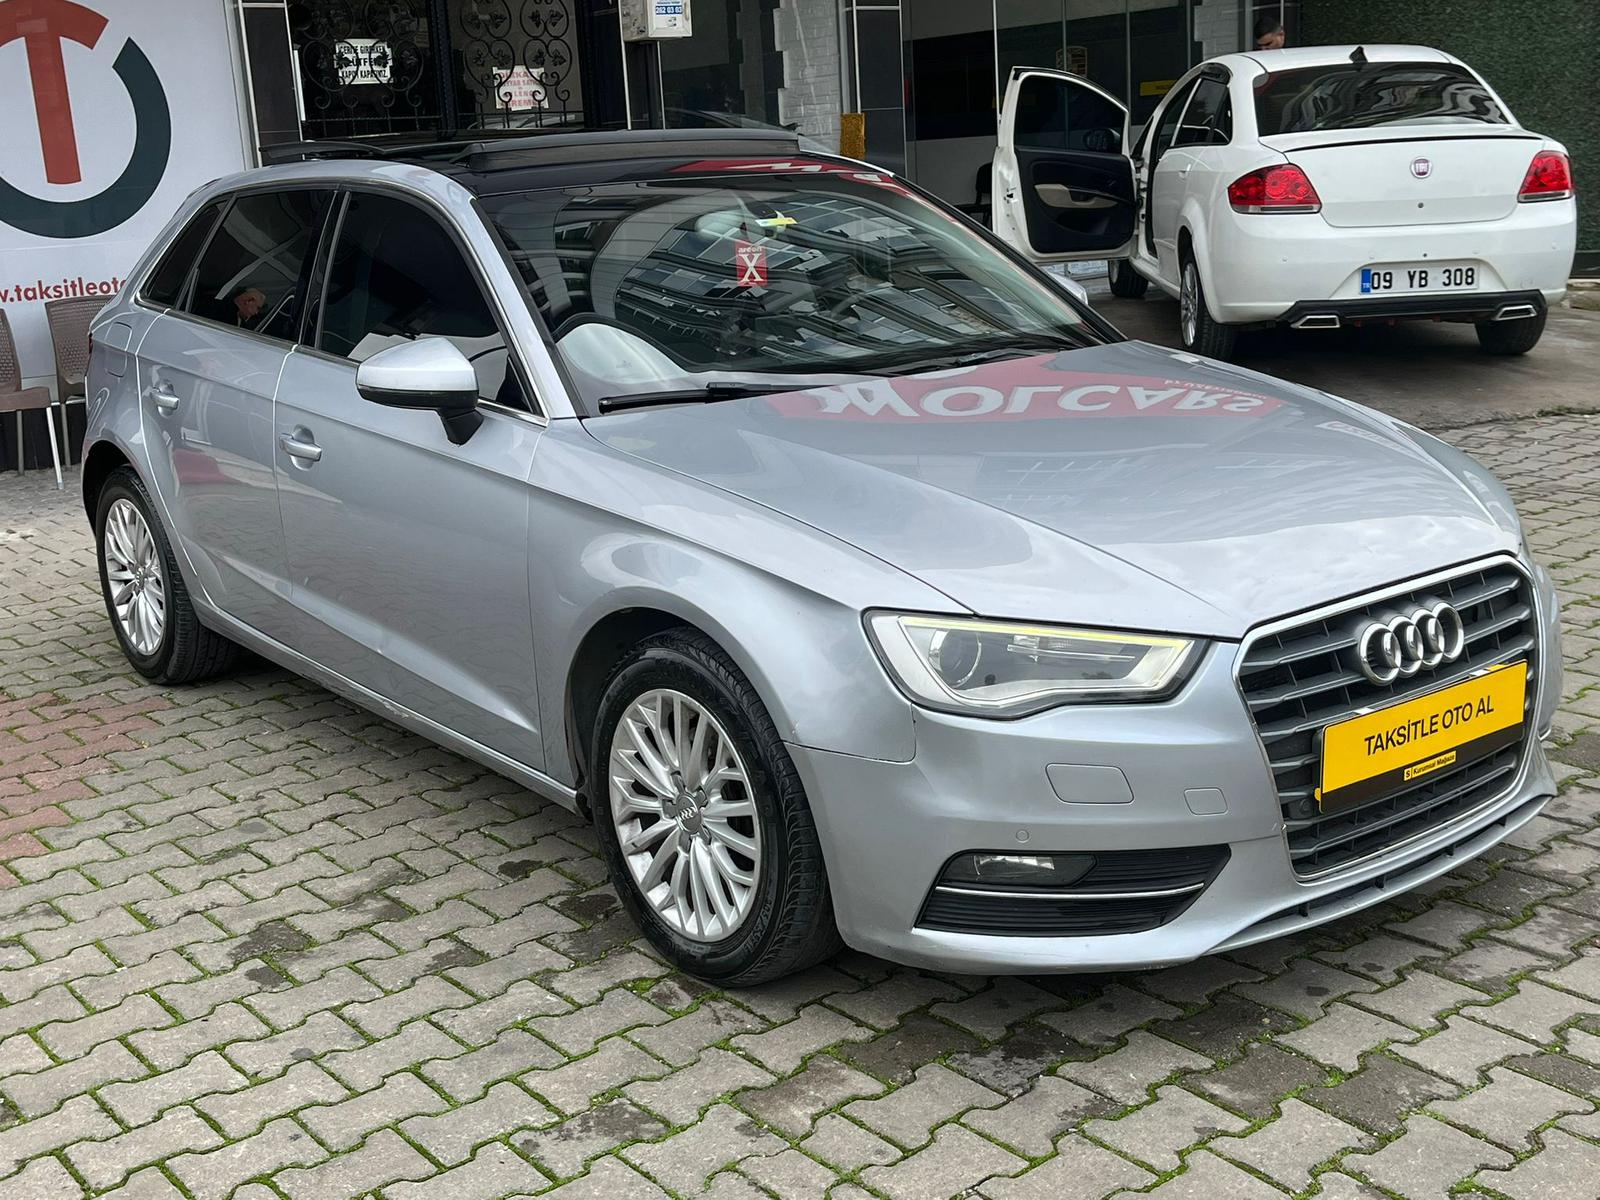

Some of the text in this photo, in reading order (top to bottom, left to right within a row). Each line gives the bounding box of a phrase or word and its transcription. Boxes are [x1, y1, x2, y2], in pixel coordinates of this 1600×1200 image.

[738, 252, 764, 283] X
[1371, 272, 1393, 290] 09
[1407, 270, 1429, 289] YB
[1442, 267, 1475, 287] 308
[1364, 695, 1494, 756] TAKSİTLE OTO AL
